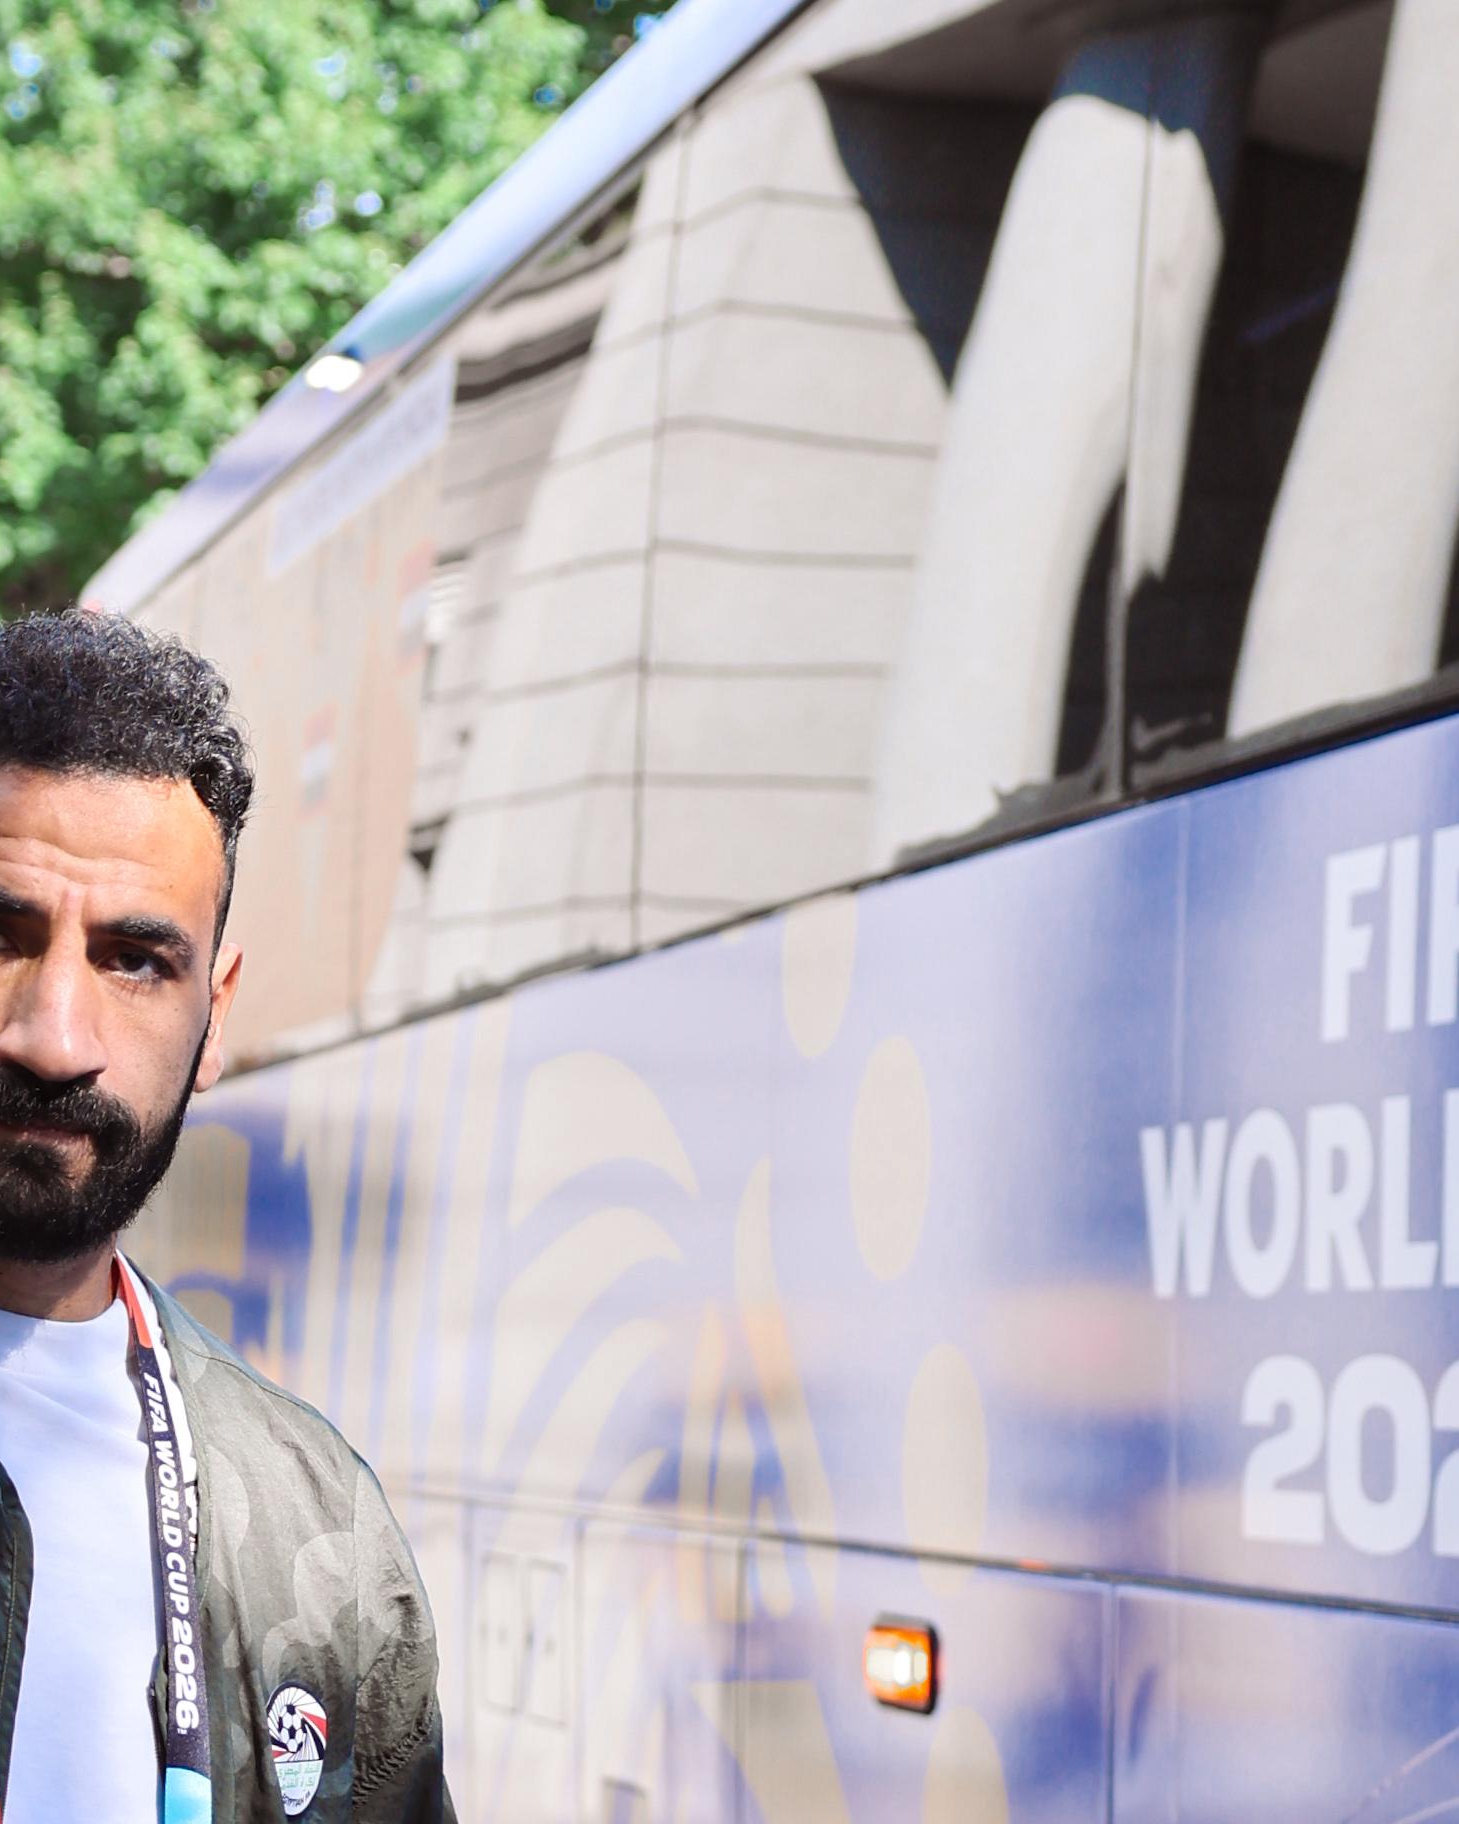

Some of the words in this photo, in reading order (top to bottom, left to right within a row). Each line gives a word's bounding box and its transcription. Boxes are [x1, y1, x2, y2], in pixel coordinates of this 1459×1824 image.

[1140, 1087, 1459, 1300] WORL
[143, 1372, 169, 1432] FIFA
[154, 1440, 183, 1548] WORLD
[166, 1552, 190, 1615] CUP
